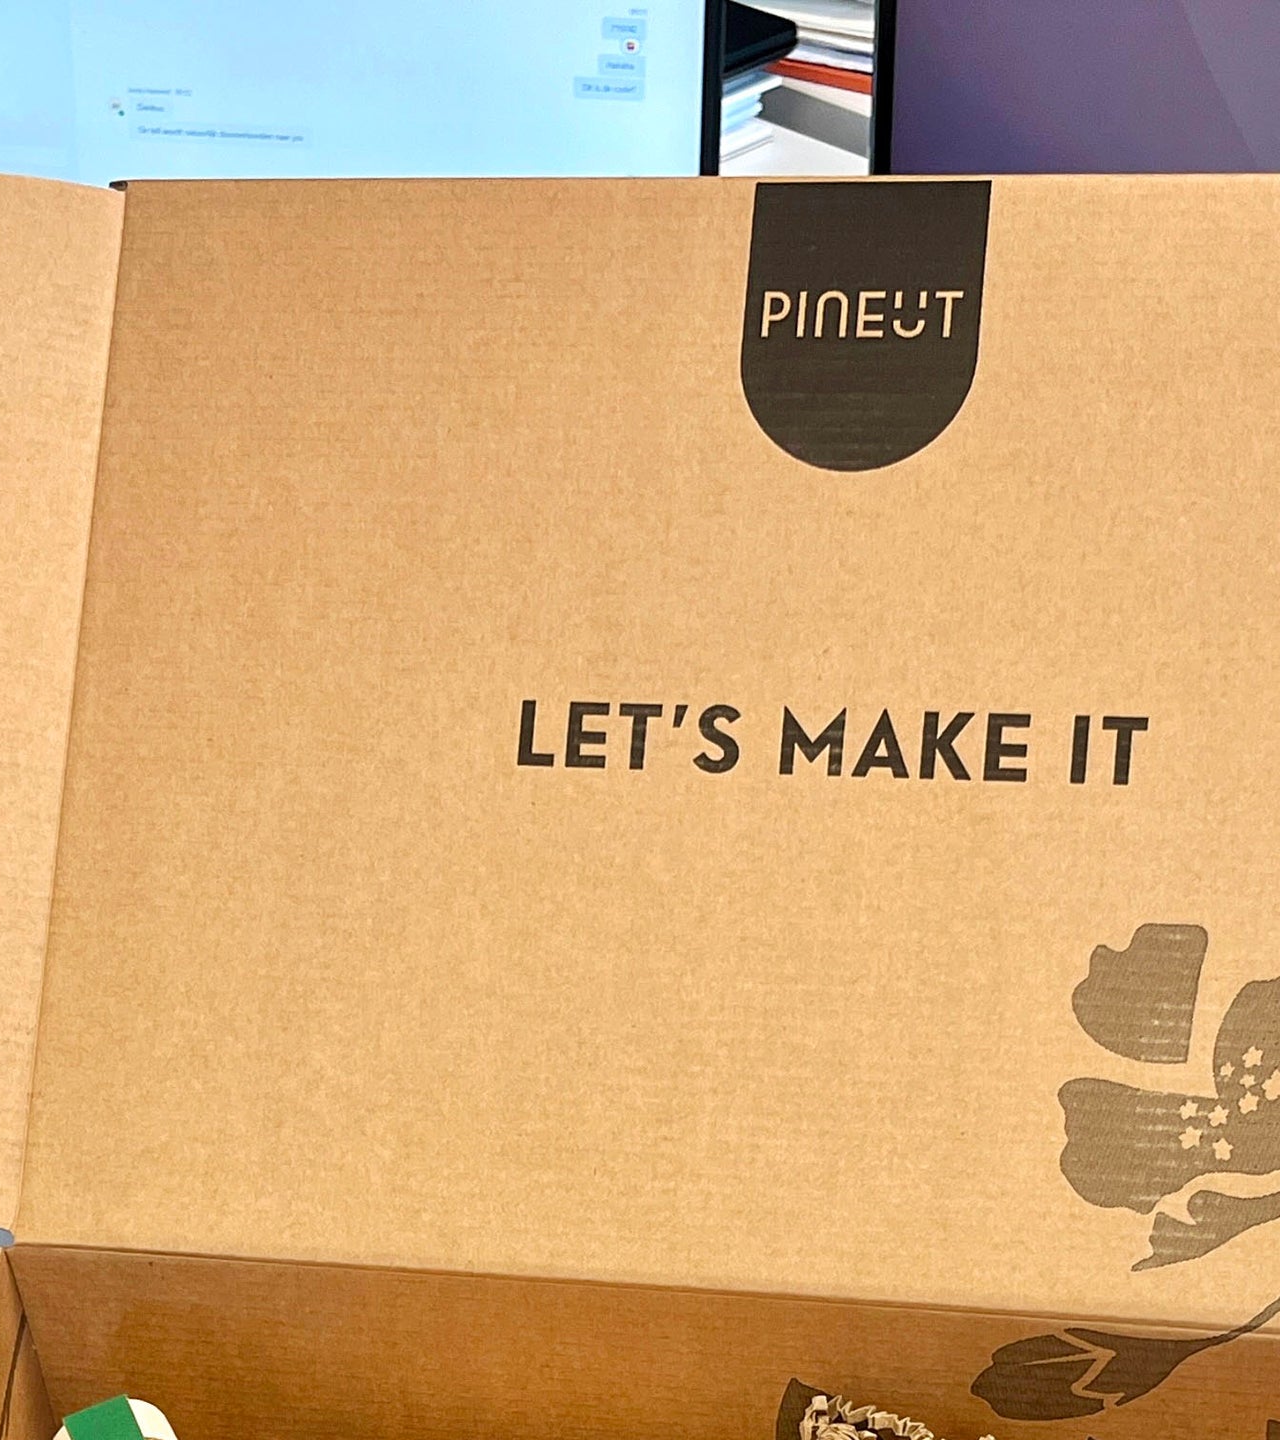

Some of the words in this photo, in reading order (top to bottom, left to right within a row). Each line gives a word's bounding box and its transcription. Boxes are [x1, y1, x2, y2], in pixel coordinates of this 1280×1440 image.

[760, 290, 964, 338] PINEUT
[517, 699, 741, 774] LET'S
[779, 706, 1031, 783] MAKE
[1069, 714, 1149, 785] IT
